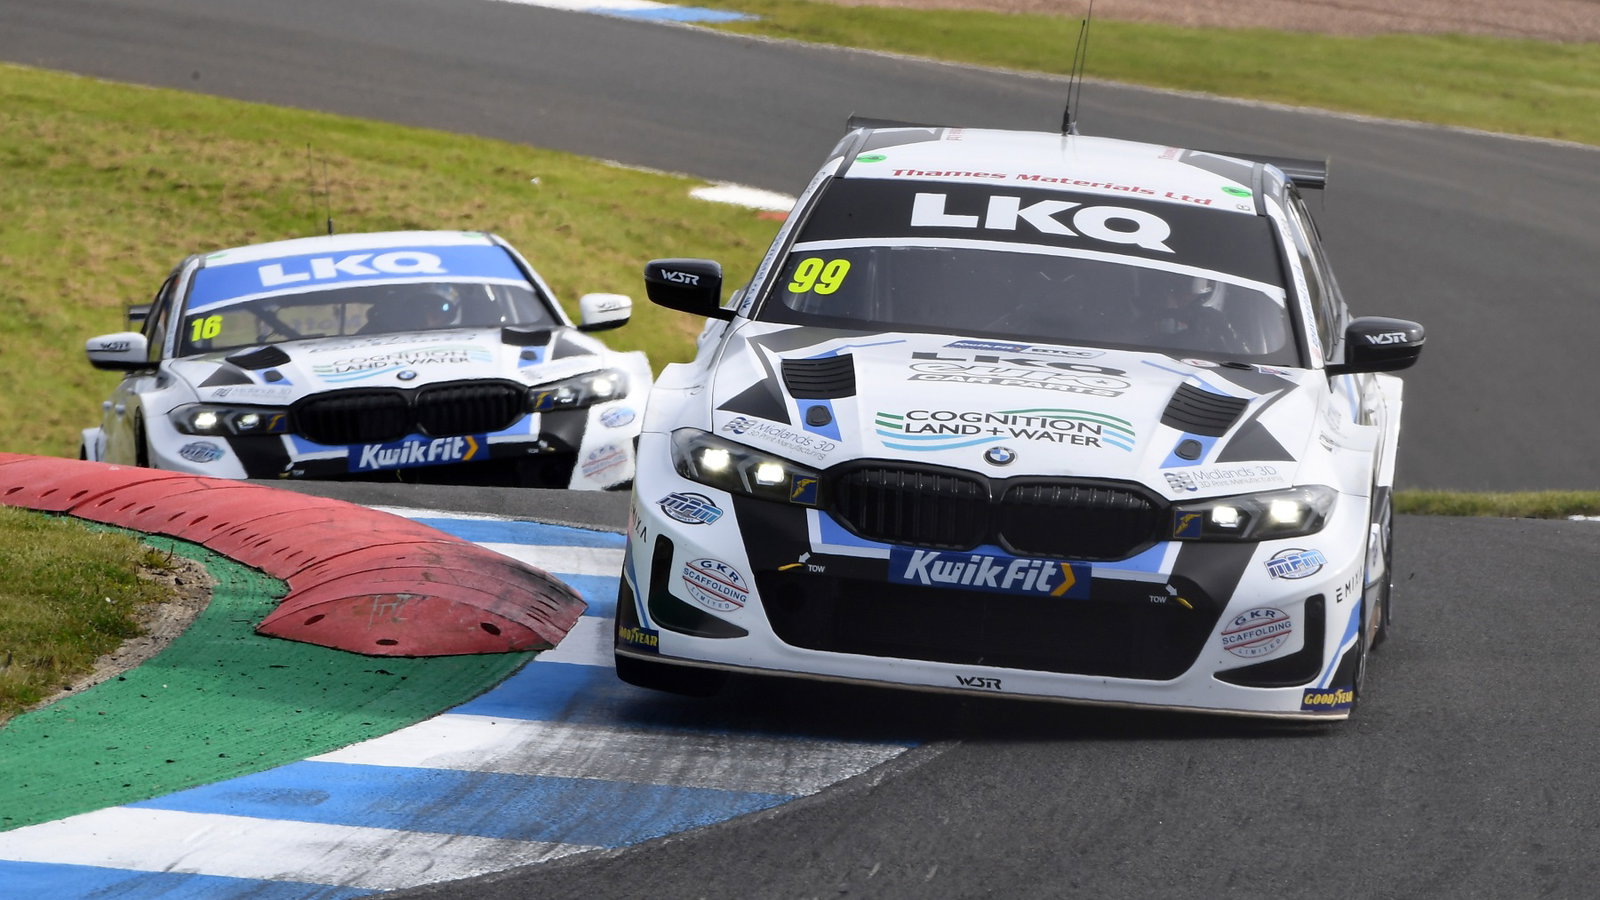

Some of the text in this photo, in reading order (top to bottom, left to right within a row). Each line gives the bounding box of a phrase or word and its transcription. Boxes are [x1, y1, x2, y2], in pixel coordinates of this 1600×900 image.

[892, 168, 1213, 206] Thames Materials Ltd
[910, 192, 1177, 254] LKQ
[257, 250, 449, 287] LKQ
[660, 268, 700, 286] WSR
[787, 257, 852, 295] 99
[191, 315, 224, 342] 16
[1365, 332, 1408, 345] WSR
[911, 351, 1130, 377] LKQ
[917, 374, 1122, 397] CAR PARTS
[905, 410, 1102, 436] COGNITION
[755, 423, 836, 453] Midlands 3D
[1192, 465, 1277, 481] Midlands 3D
[701, 559, 740, 583] GKR
[808, 564, 825, 573] TOW
[683, 567, 748, 603] SCAFFOLDING
[691, 587, 730, 610] LIMITED
[1149, 595, 1168, 604] TOW
[1234, 609, 1277, 626] GKR
[1222, 621, 1292, 645] SCAFFOLDING
[1238, 638, 1282, 655] LIMITED
[955, 675, 1002, 690] WSR
